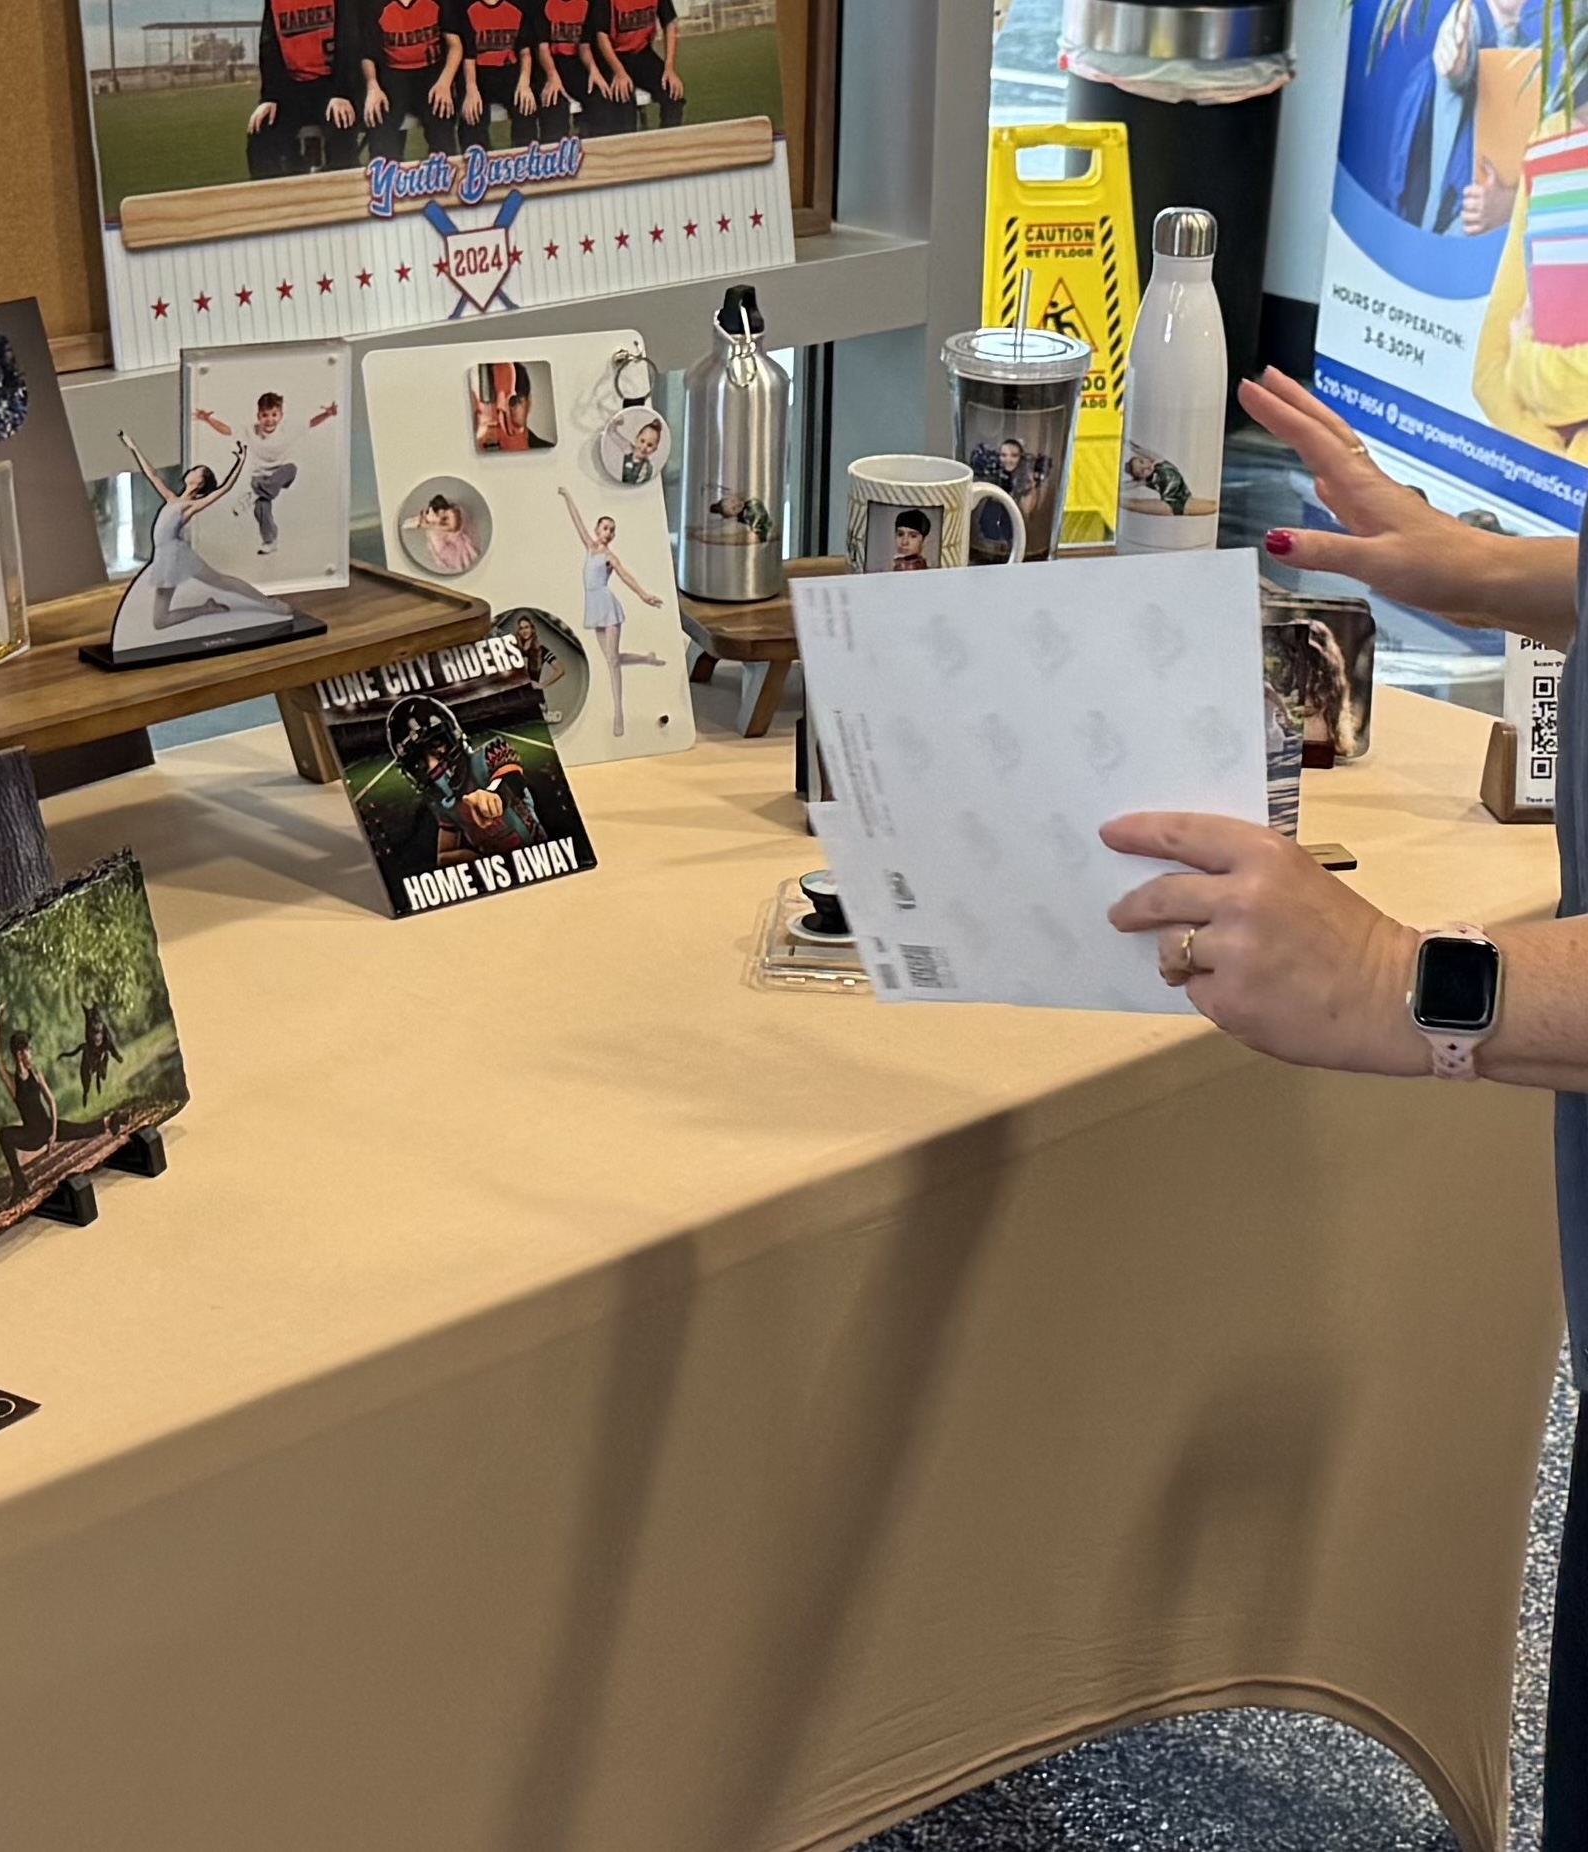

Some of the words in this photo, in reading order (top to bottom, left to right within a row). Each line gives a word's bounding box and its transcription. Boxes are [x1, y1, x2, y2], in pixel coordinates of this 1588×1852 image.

[367, 151, 457, 219] Youth
[458, 135, 584, 205] Baseball
[1025, 227, 1095, 242] CAUTION
[453, 244, 503, 277] 2024
[1025, 249, 1050, 258] WET
[1055, 248, 1094, 258] FLOOR
[1332, 283, 1369, 315] HOURS
[1371, 299, 1386, 316] OF
[380, 654, 435, 694] CITY
[437, 634, 525, 683] RIDERS
[403, 863, 478, 911] HOME
[474, 854, 512, 892] VS
[511, 837, 579, 884] AWAY
